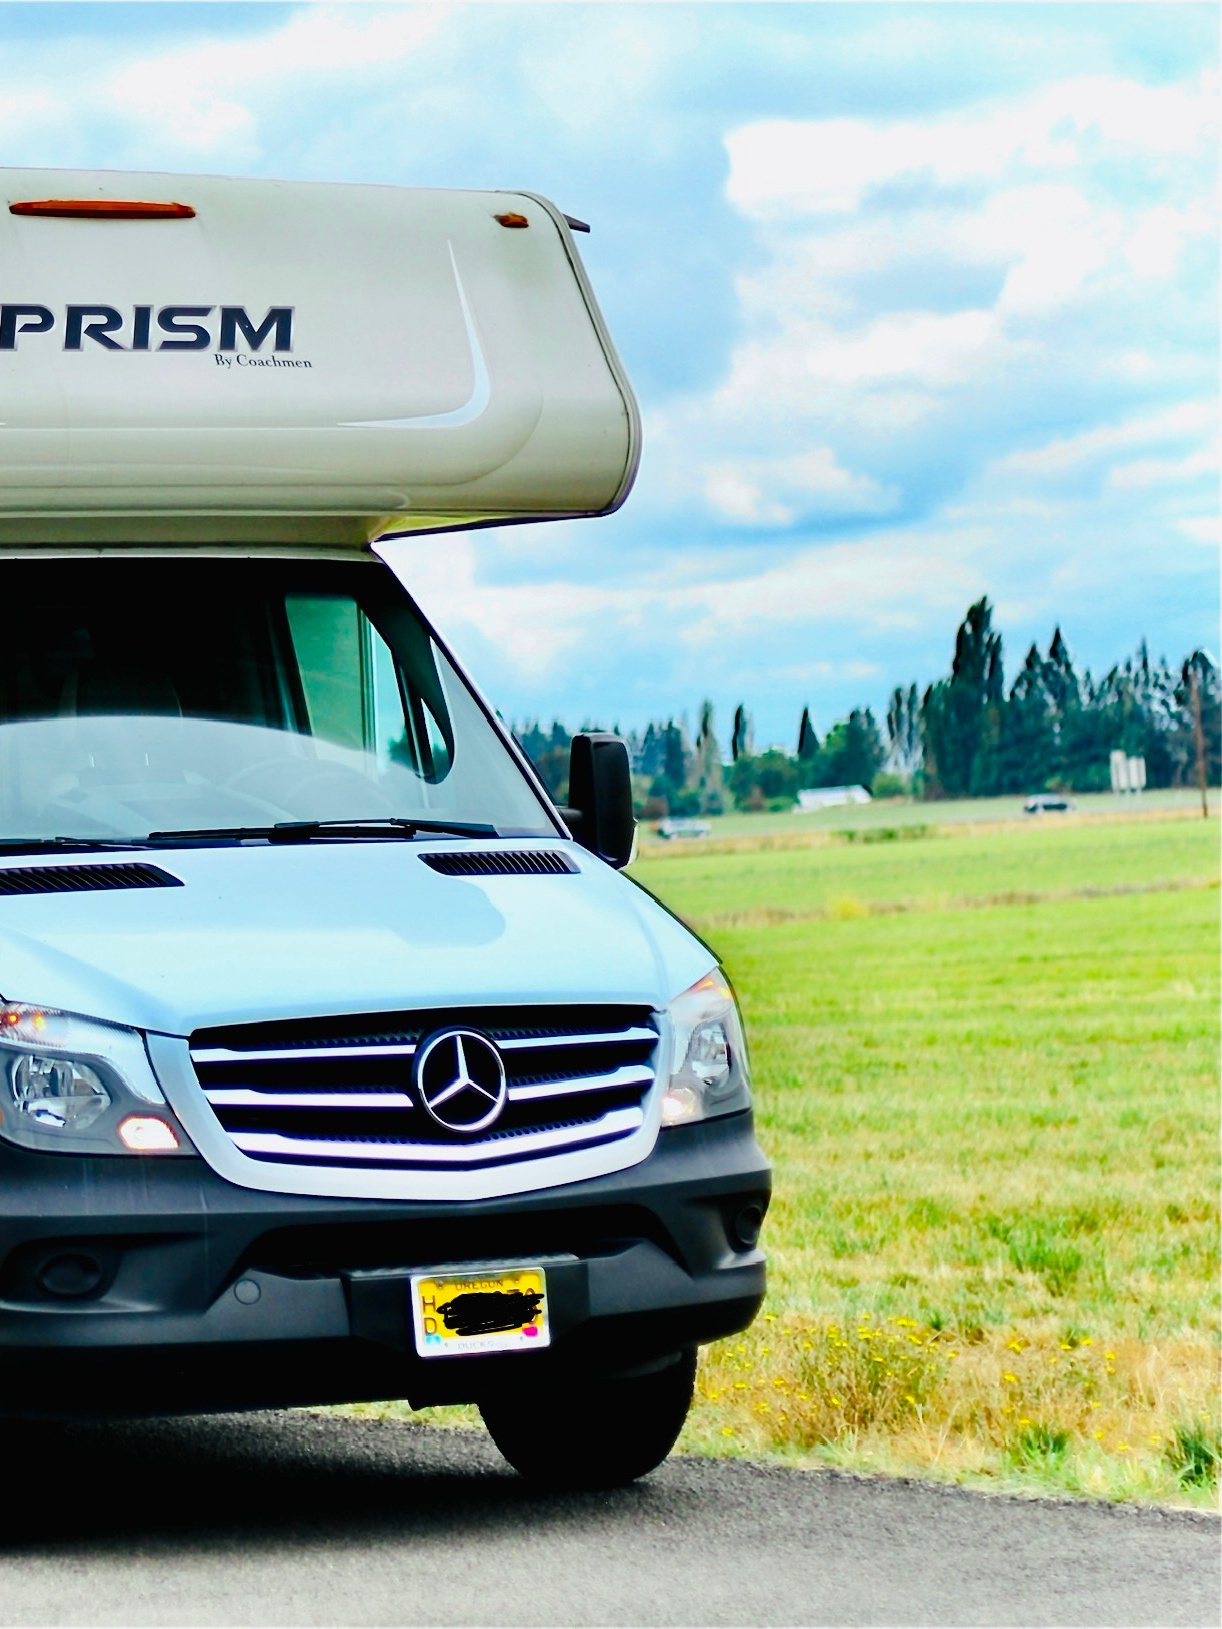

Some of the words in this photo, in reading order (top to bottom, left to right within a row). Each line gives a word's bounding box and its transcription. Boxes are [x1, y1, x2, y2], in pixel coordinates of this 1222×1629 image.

[214, 353, 232, 369] By
[236, 354, 313, 368] Coachmen
[455, 1279, 504, 1291] OREGON
